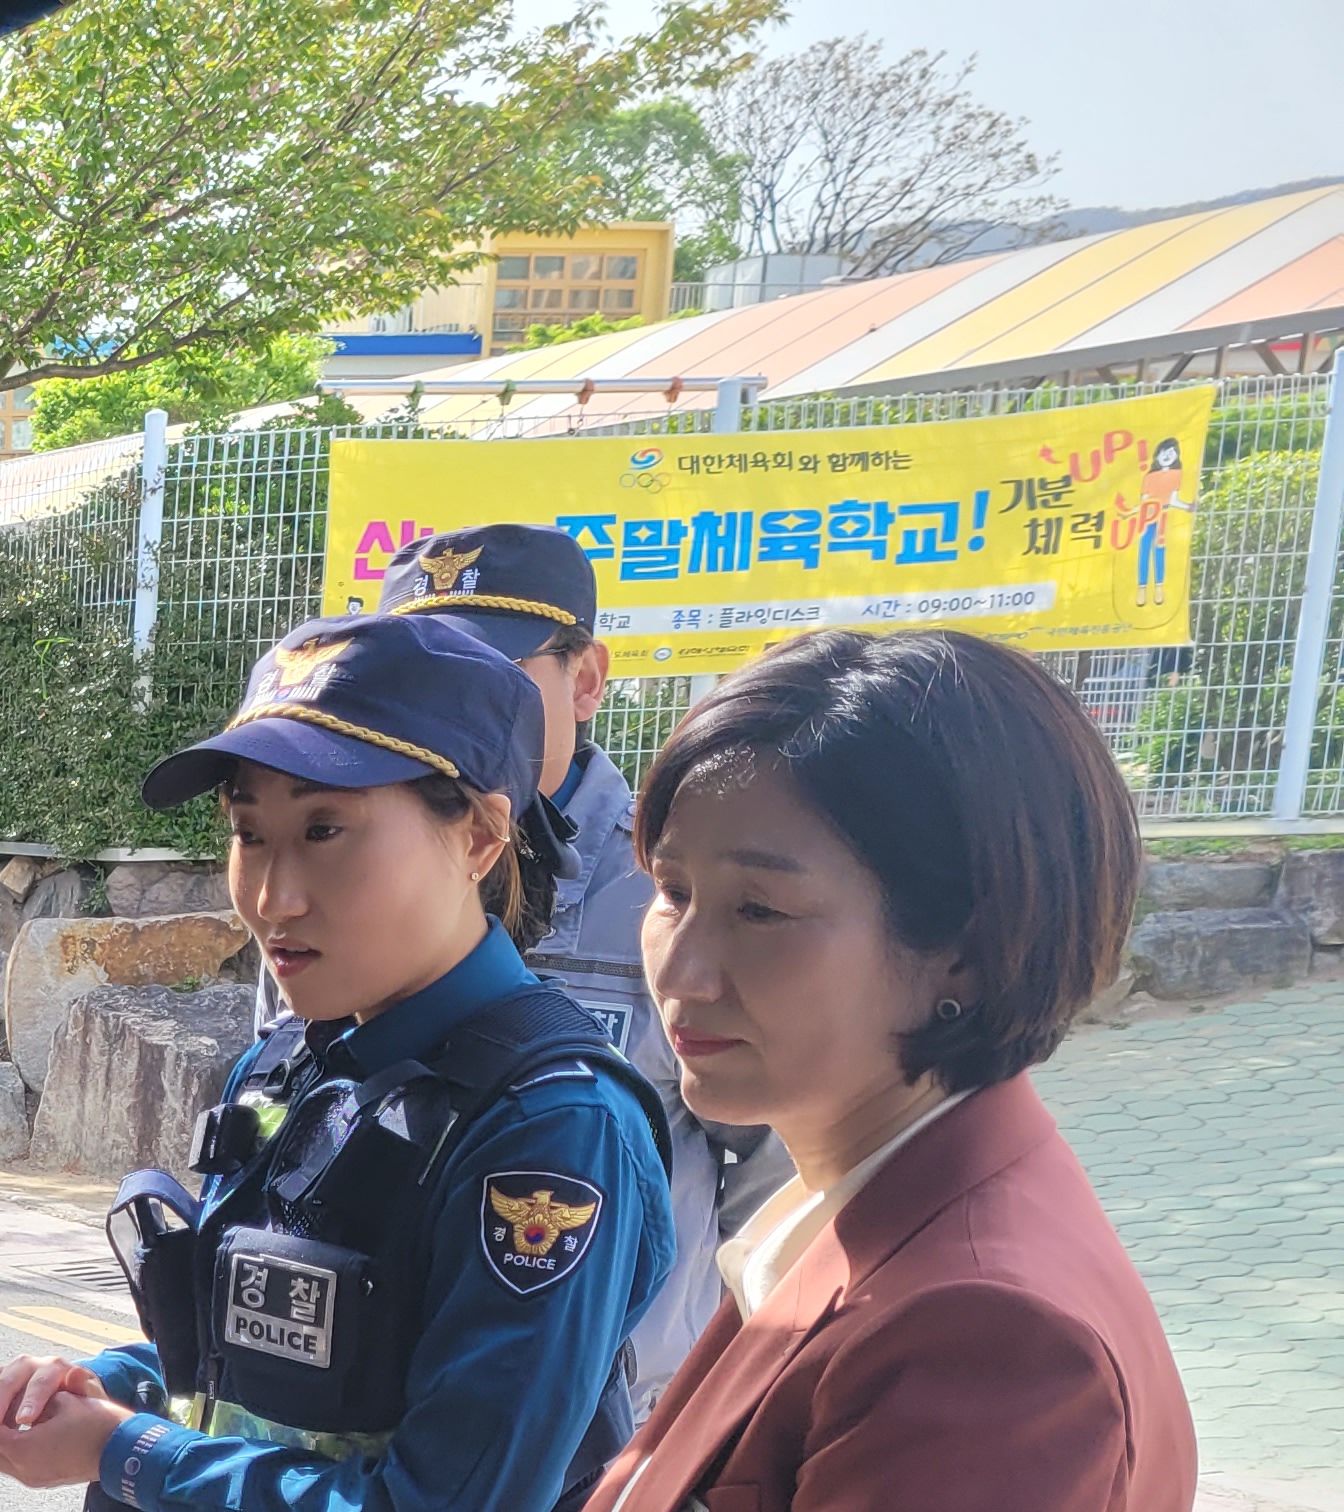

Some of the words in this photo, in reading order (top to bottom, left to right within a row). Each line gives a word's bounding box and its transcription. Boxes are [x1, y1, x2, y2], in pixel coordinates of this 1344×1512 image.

[677, 451, 794, 475] 대한체육회
[798, 454, 820, 473] 와
[827, 450, 914, 473] 함께하는
[998, 474, 1075, 515] 기분
[1069, 430, 1148, 483] UP!
[1110, 500, 1168, 551] UP!
[595, 612, 631, 632] 학교
[672, 608, 702, 630] 종목
[719, 606, 821, 629] 플라잉디스크
[861, 600, 900, 618] 시간
[917, 590, 1036, 614] 09:00~11:00
[492, 1226, 507, 1242] 경
[563, 1234, 579, 1253] 찰
[503, 1252, 557, 1271] POLICE
[234, 1314, 318, 1355] POLICE
